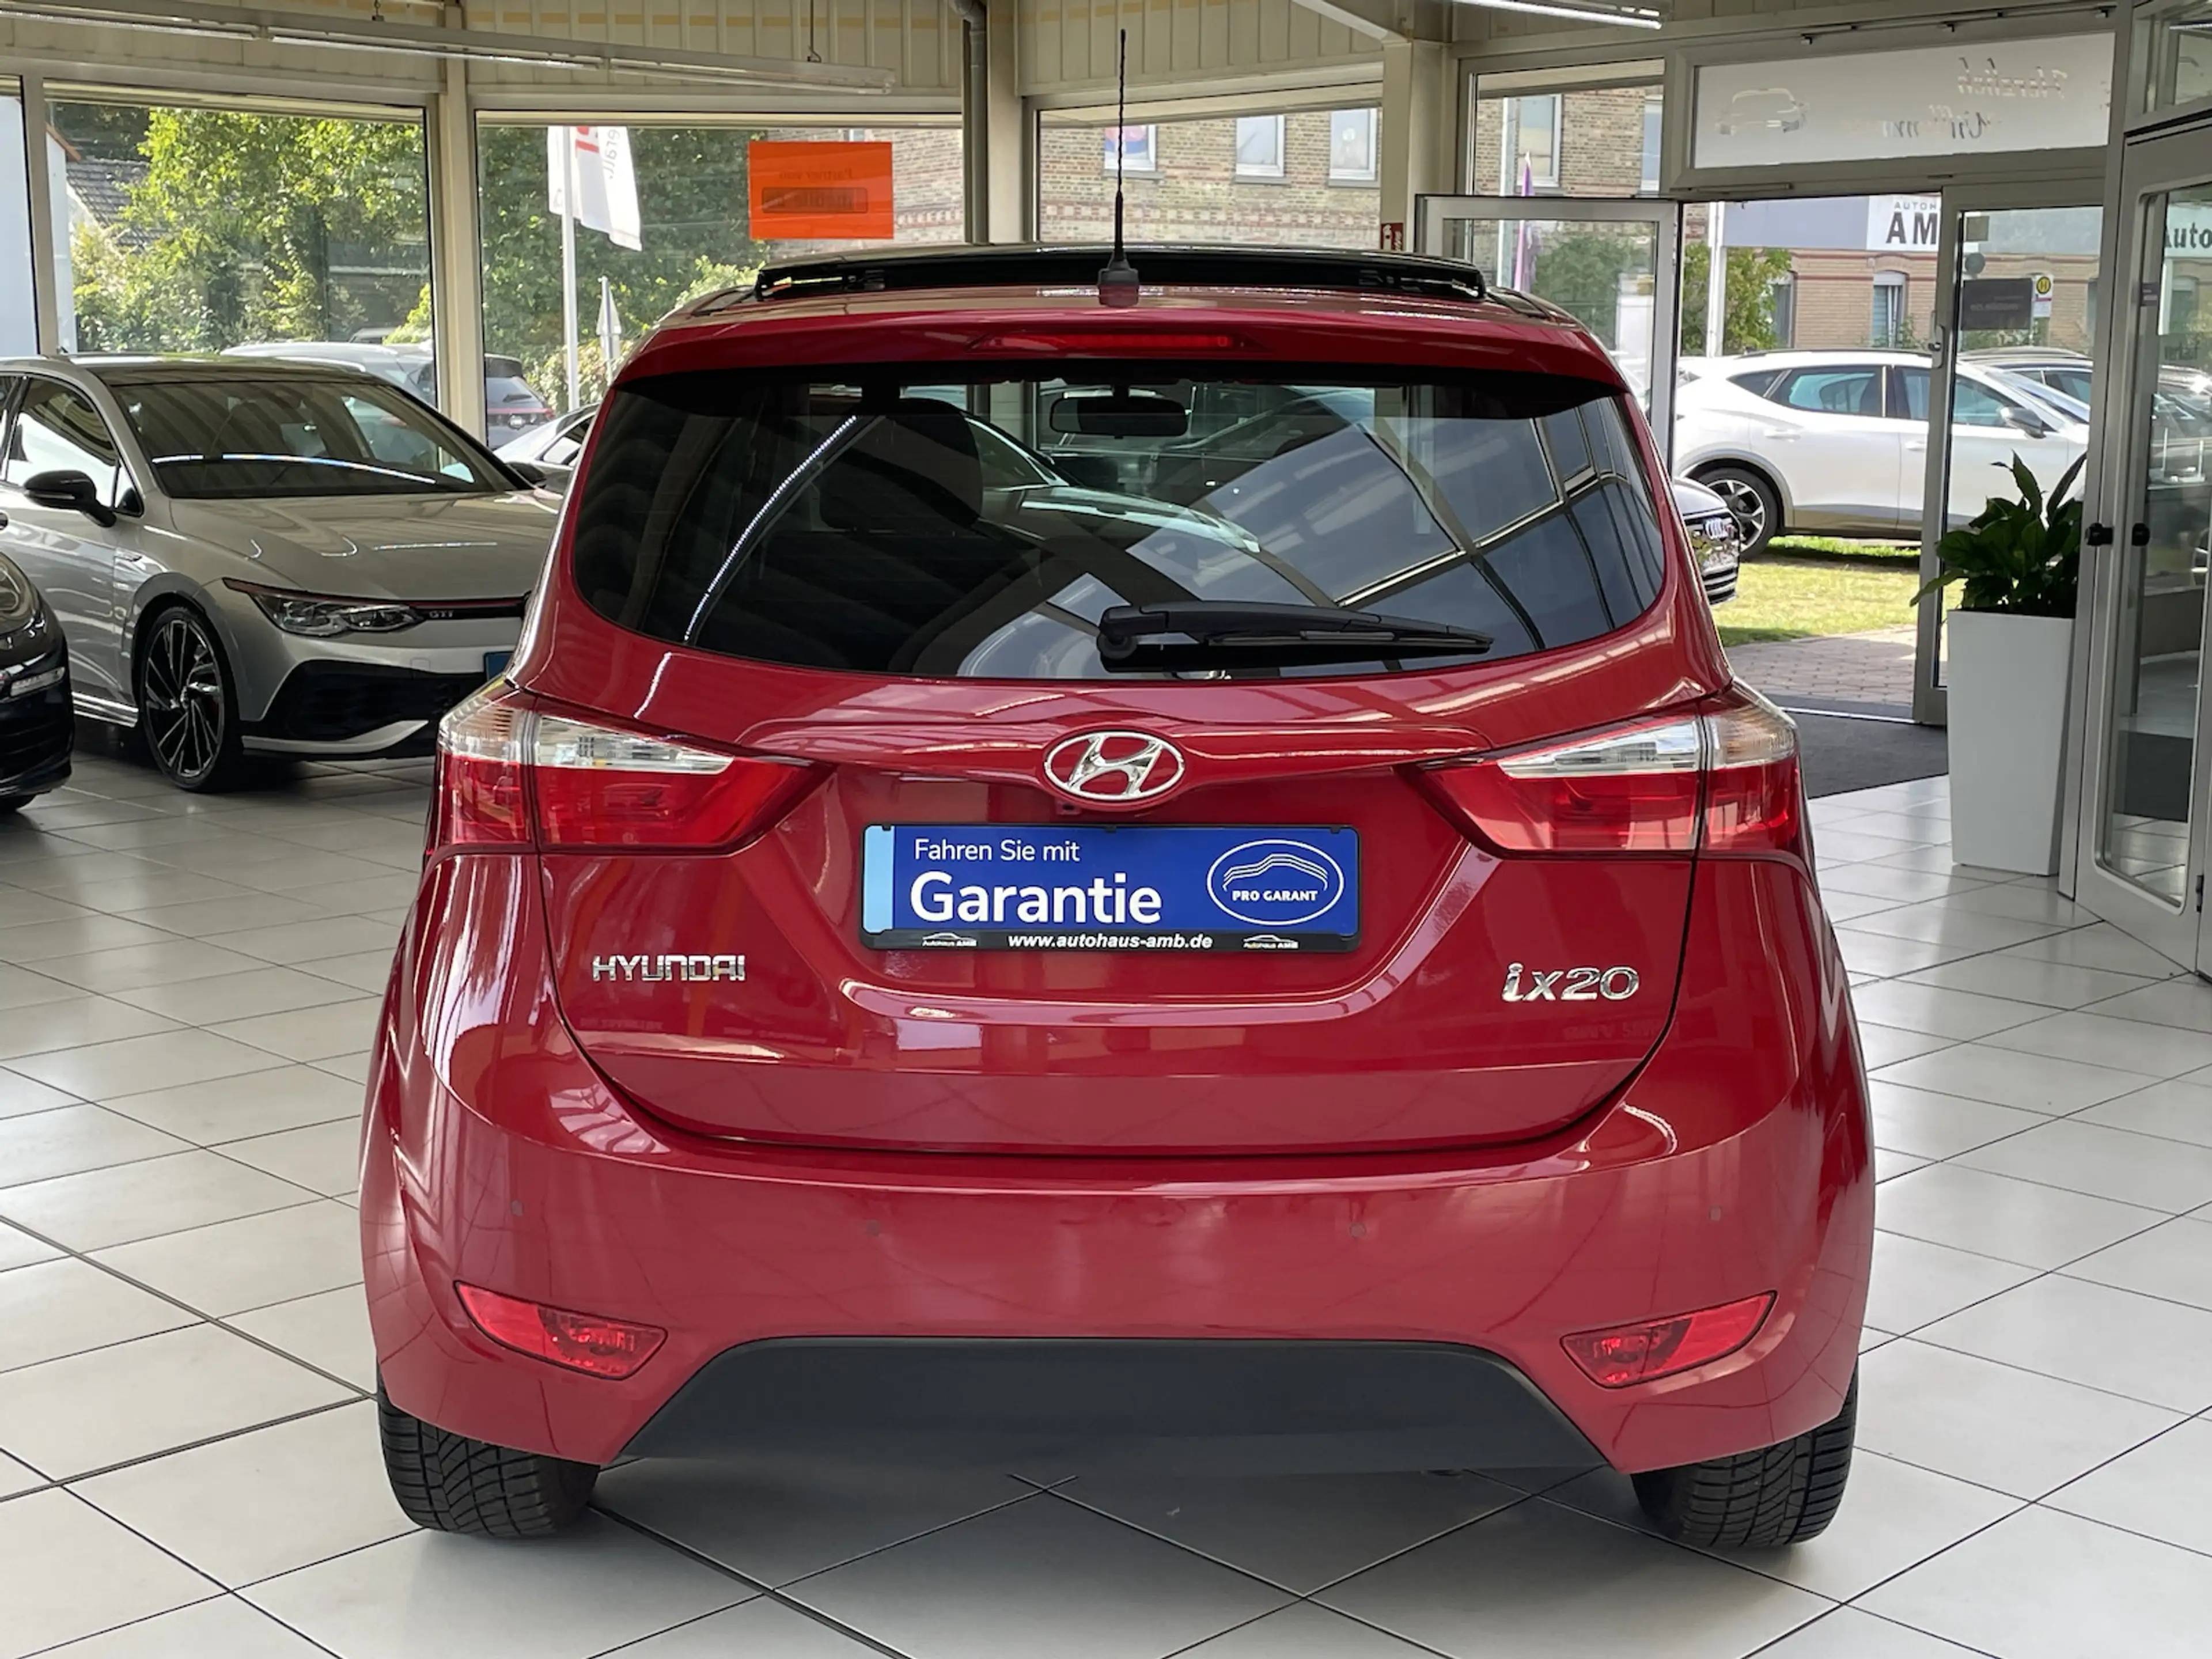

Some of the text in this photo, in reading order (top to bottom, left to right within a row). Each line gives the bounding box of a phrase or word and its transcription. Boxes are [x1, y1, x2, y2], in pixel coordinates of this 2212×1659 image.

[915, 839, 1081, 862] Fahren Sie mit
[910, 870, 1162, 924] Garantie
[1232, 890, 1318, 902] PRO GARANT
[1008, 933, 1213, 949] www.autohaus-amb.de
[593, 955, 745, 981] HYUNDAI
[1501, 961, 1641, 1002] ix20
